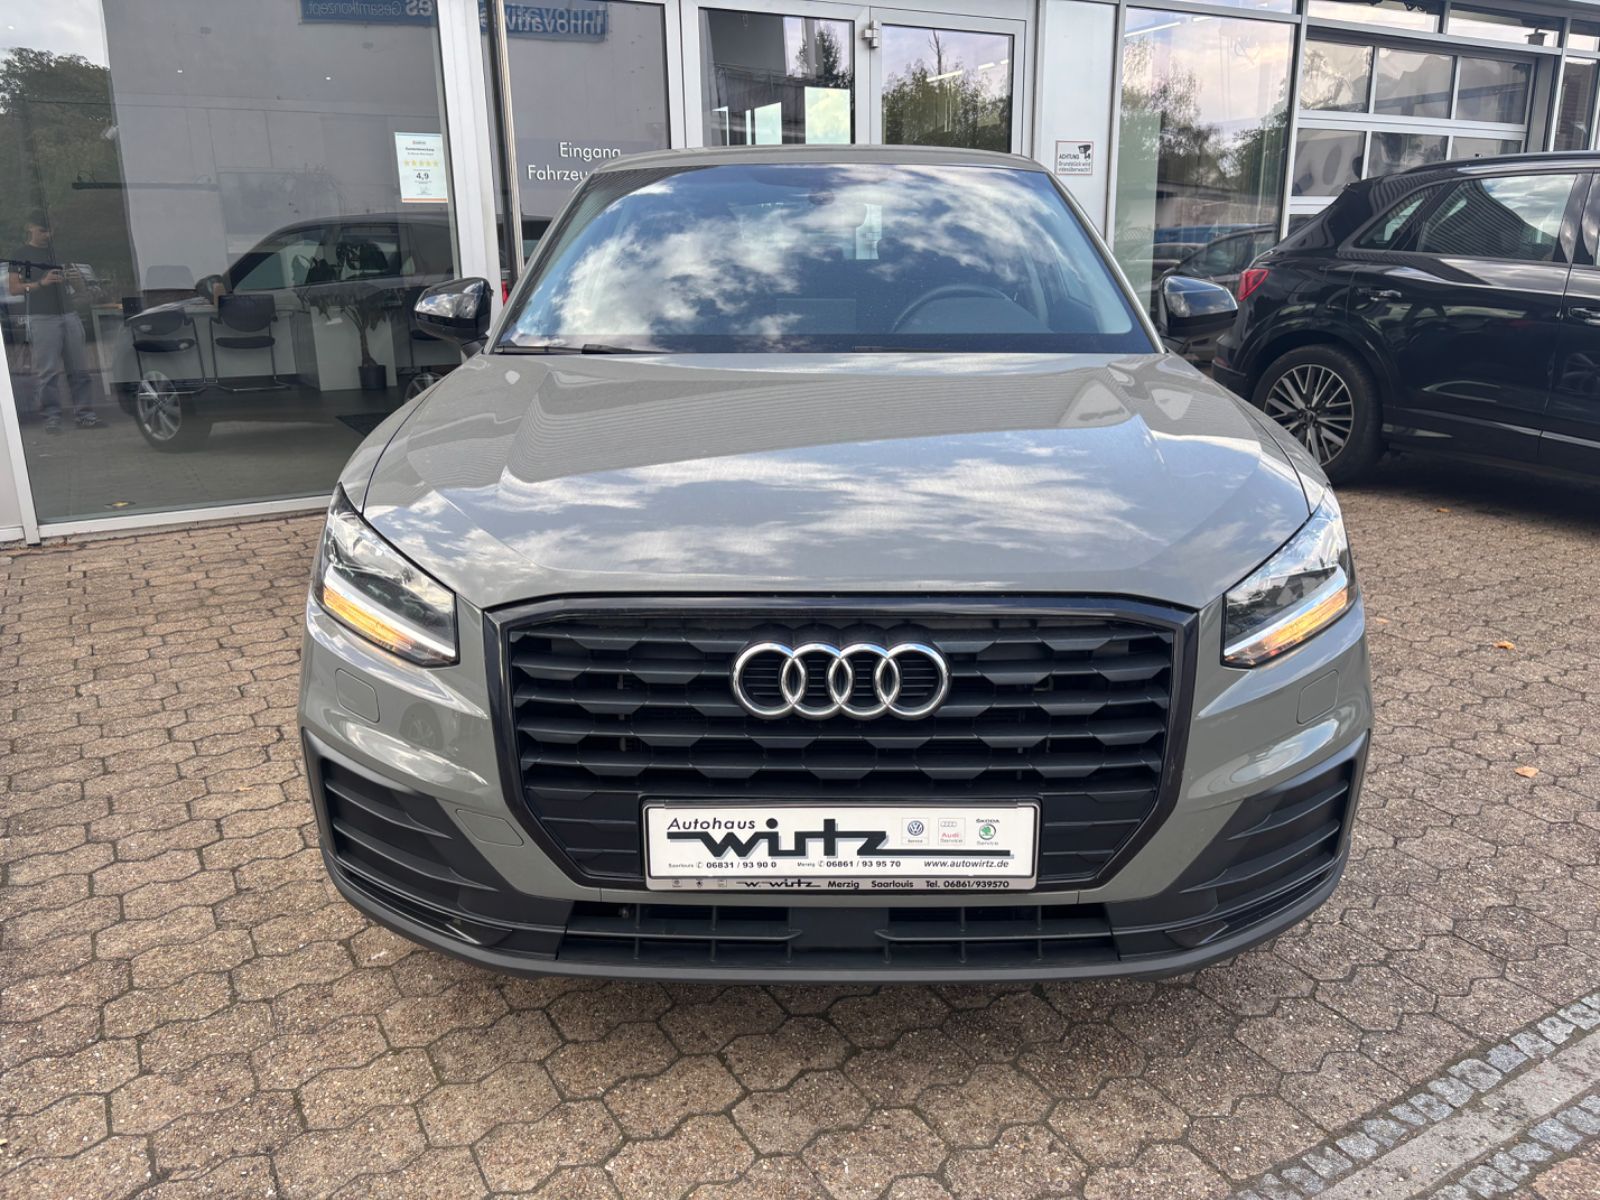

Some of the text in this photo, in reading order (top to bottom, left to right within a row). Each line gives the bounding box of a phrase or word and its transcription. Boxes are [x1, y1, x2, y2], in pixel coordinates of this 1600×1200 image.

[667, 817, 756, 830] Autohaus
[924, 859, 1009, 868] www.autowirtz.de
[827, 880, 860, 889] Merzig
[871, 880, 914, 888] Saarlouis
[926, 880, 940, 888] Tel.
[943, 880, 1010, 888] 06861/939570
